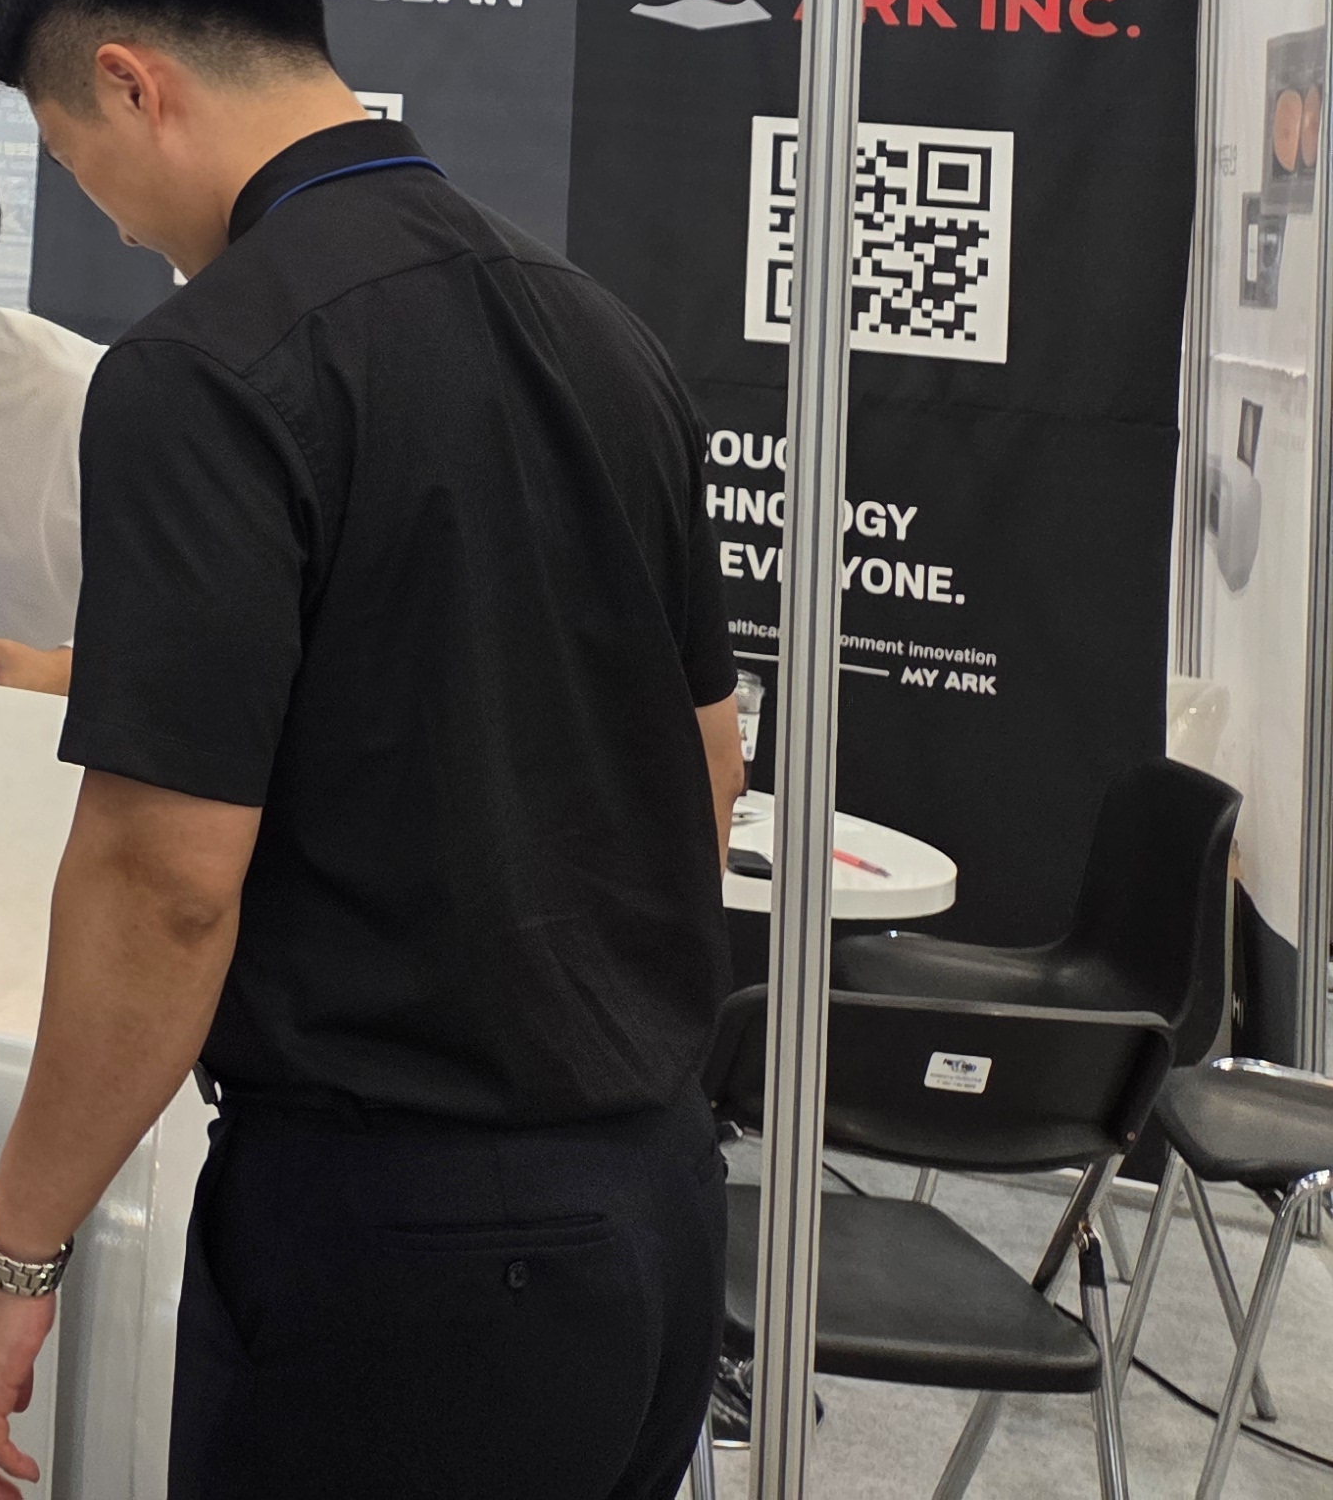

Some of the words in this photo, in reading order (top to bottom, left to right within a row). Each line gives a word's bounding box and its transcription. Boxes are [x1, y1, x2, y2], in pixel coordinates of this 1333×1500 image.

[728, 618, 782, 640] althca
[839, 633, 904, 656] onment
[908, 640, 997, 668] innovation
[900, 665, 939, 688] MY
[944, 673, 998, 696] ARK
